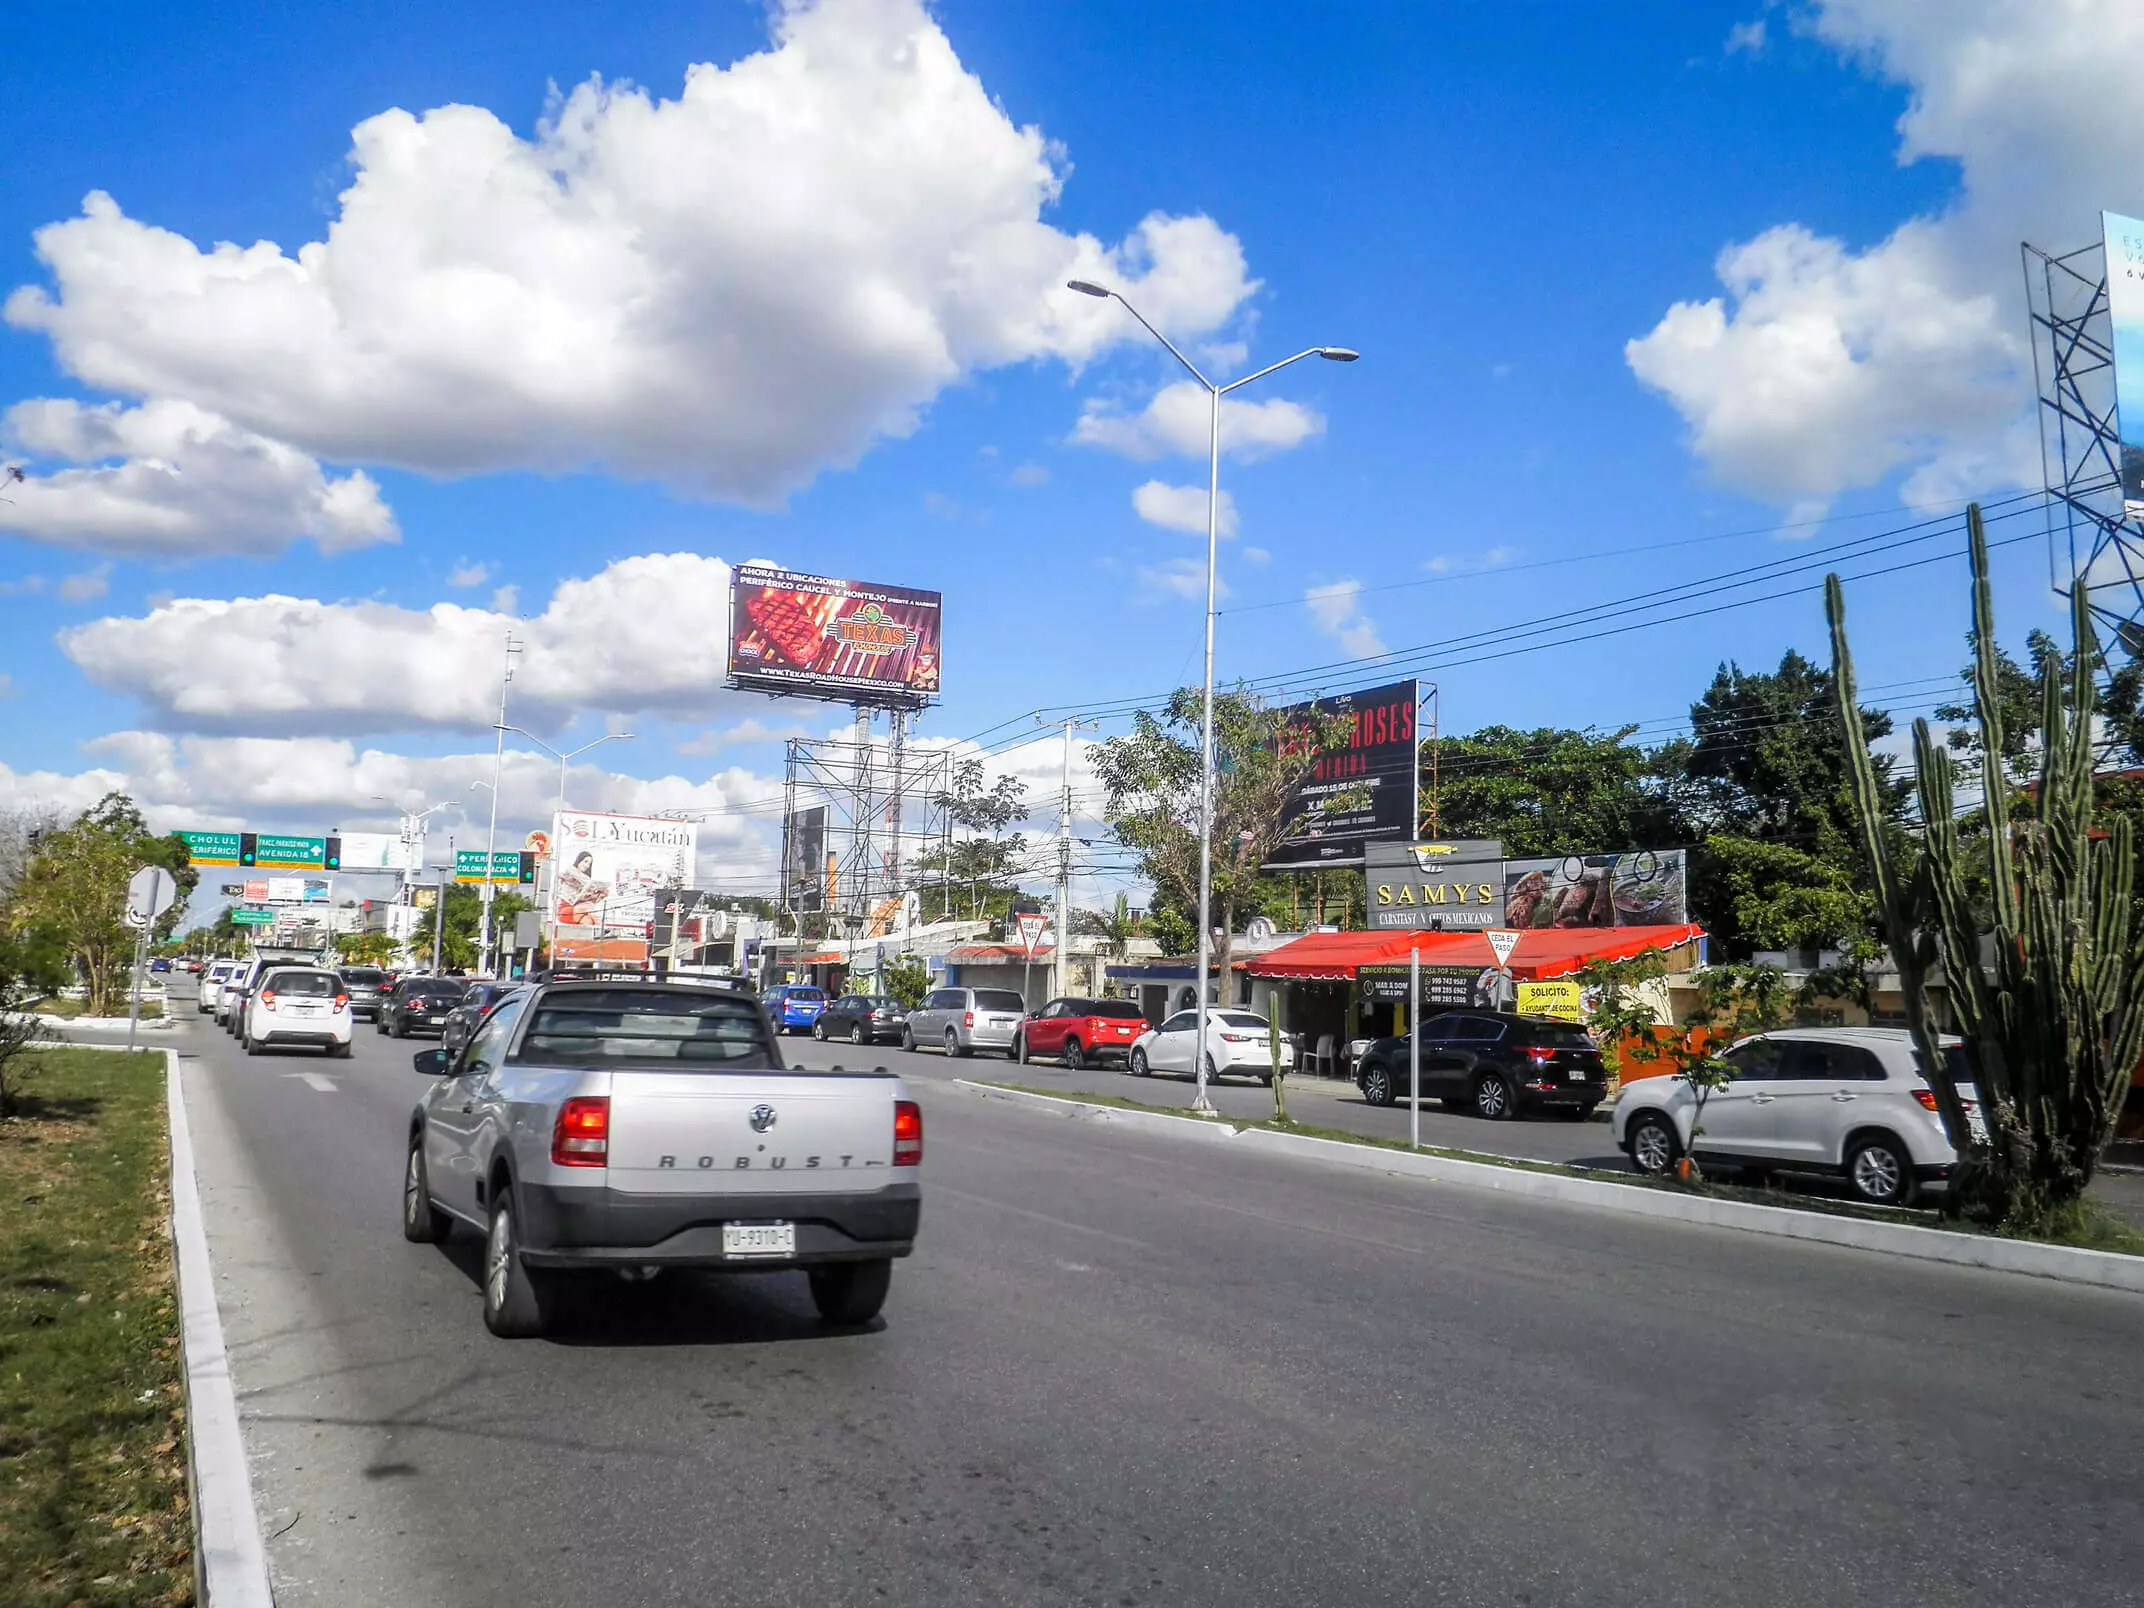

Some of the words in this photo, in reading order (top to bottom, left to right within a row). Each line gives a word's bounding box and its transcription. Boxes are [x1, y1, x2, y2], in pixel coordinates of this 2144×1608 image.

[740, 567, 775, 579] AHORA
[777, 571, 784, 579] 2
[786, 572, 848, 588] UBICACIONES
[740, 576, 794, 590] PERIFÉRICO
[795, 583, 832, 596] CAUCEL
[834, 588, 841, 597] Y
[843, 589, 887, 602] MONTEJO
[840, 622, 905, 645] TEXAS
[1350, 701, 1413, 750] ROSES
[189, 835, 237, 845] CHOLUL
[259, 849, 298, 858] AVENIDA
[457, 865, 487, 873] COLONIA
[1377, 883, 1494, 906] SAMYS
[1452, 912, 1493, 925] MEXICANOS
[1491, 934, 1505, 942] CEDA
[1506, 934, 1514, 943] EL
[1495, 944, 1511, 952] PASO
[1530, 987, 1570, 997] SOLICITO:
[659, 1155, 854, 1169] ROBUST
